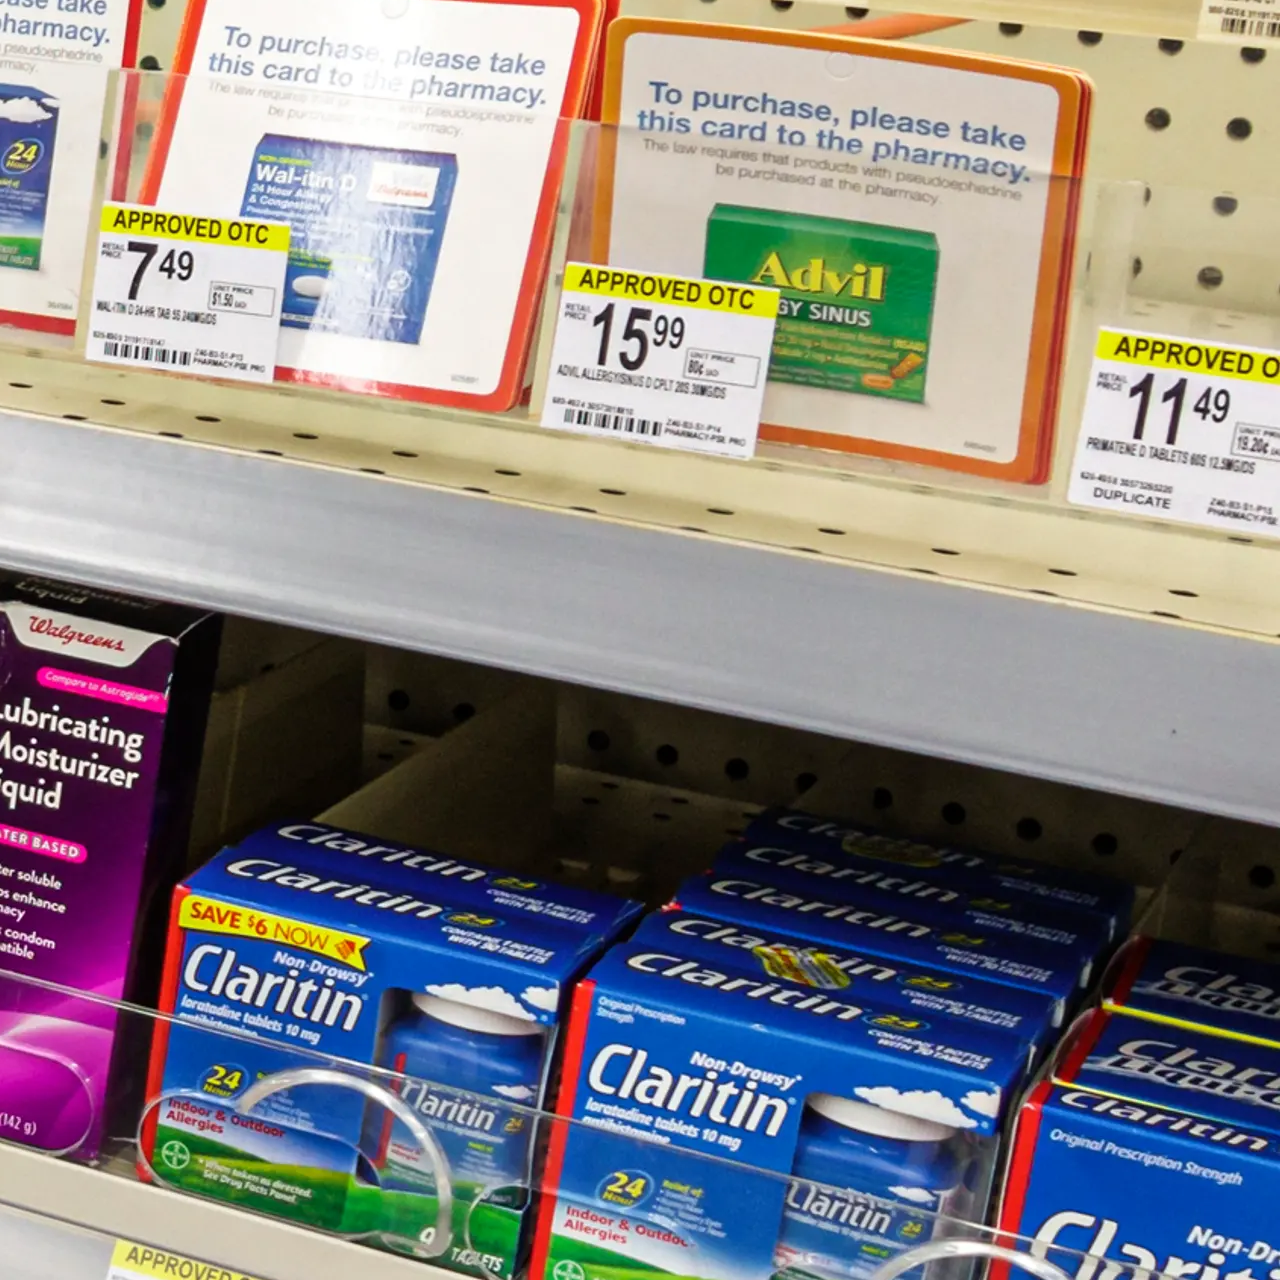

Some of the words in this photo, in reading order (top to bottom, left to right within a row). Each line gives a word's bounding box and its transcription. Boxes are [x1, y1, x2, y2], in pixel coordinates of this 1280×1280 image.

[649, 80, 682, 106] To
[691, 89, 841, 127] purchase,
[850, 107, 949, 139] please
[961, 123, 1026, 152] take
[8, 143, 37, 162] 24
[637, 110, 693, 136] this
[701, 114, 766, 145] card
[776, 129, 806, 149] to
[816, 130, 863, 156] the
[872, 136, 1031, 183] pharmacy.
[113, 210, 221, 240] APPROVED
[227, 224, 268, 244] OTC
[749, 251, 886, 303] Advil
[809, 302, 871, 327] SINUS
[1114, 335, 1252, 376] APPROVED
[1094, 487, 1171, 510] DUPLICATE
[30, 616, 124, 652] Walgreens
[32, 840, 79, 857] BASED
[190, 902, 244, 934] SAVE
[247, 916, 267, 936] $6
[274, 922, 328, 952] NOW
[184, 944, 362, 1032] Claritin
[588, 1044, 788, 1137] Claritin
[1051, 1128, 1099, 1153] Original
[1103, 1137, 1181, 1172] Prescription
[1185, 1158, 1242, 1185] Strength
